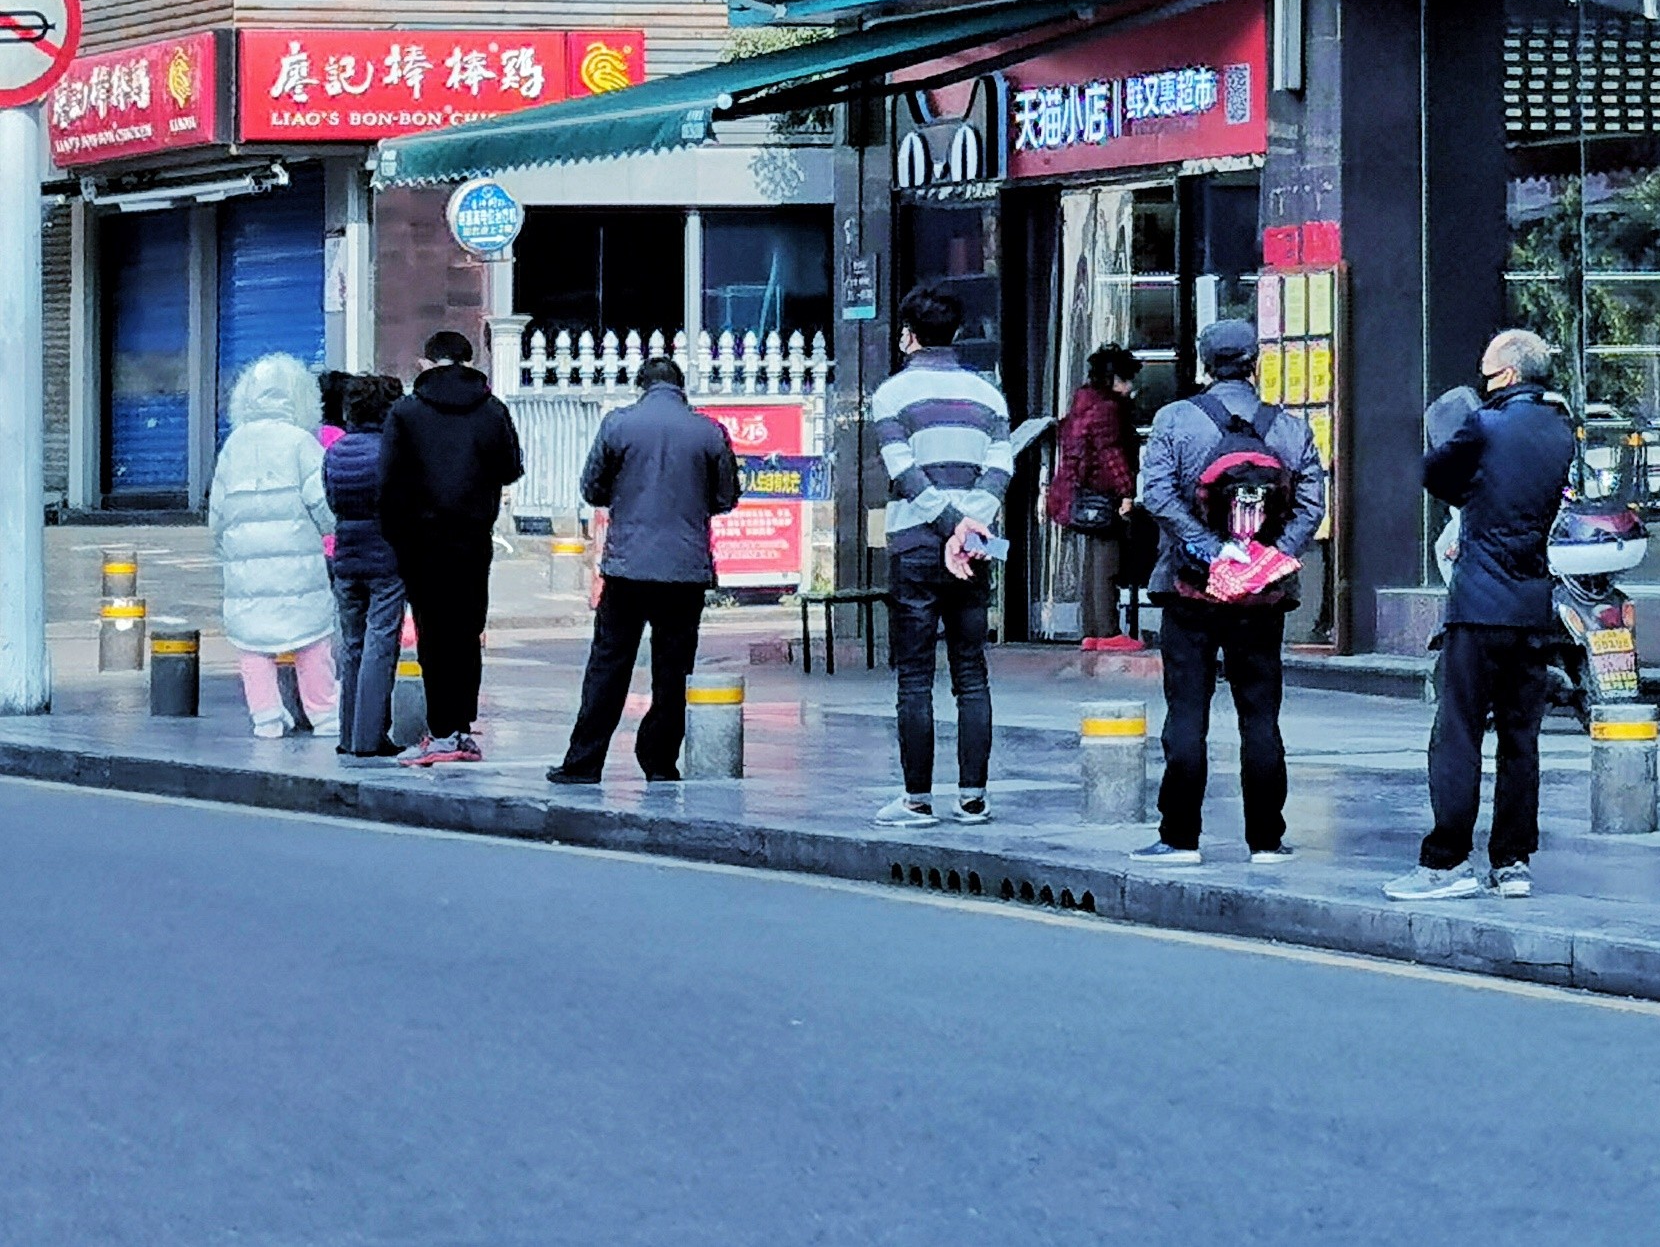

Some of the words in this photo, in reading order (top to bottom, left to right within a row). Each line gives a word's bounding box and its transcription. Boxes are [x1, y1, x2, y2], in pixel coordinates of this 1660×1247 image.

[270, 111, 340, 127] LIAO'S
[349, 111, 443, 127] BON-BON
[1014, 83, 1108, 150] 天猫小店
[1126, 67, 1216, 120] 鲜又惠超市
